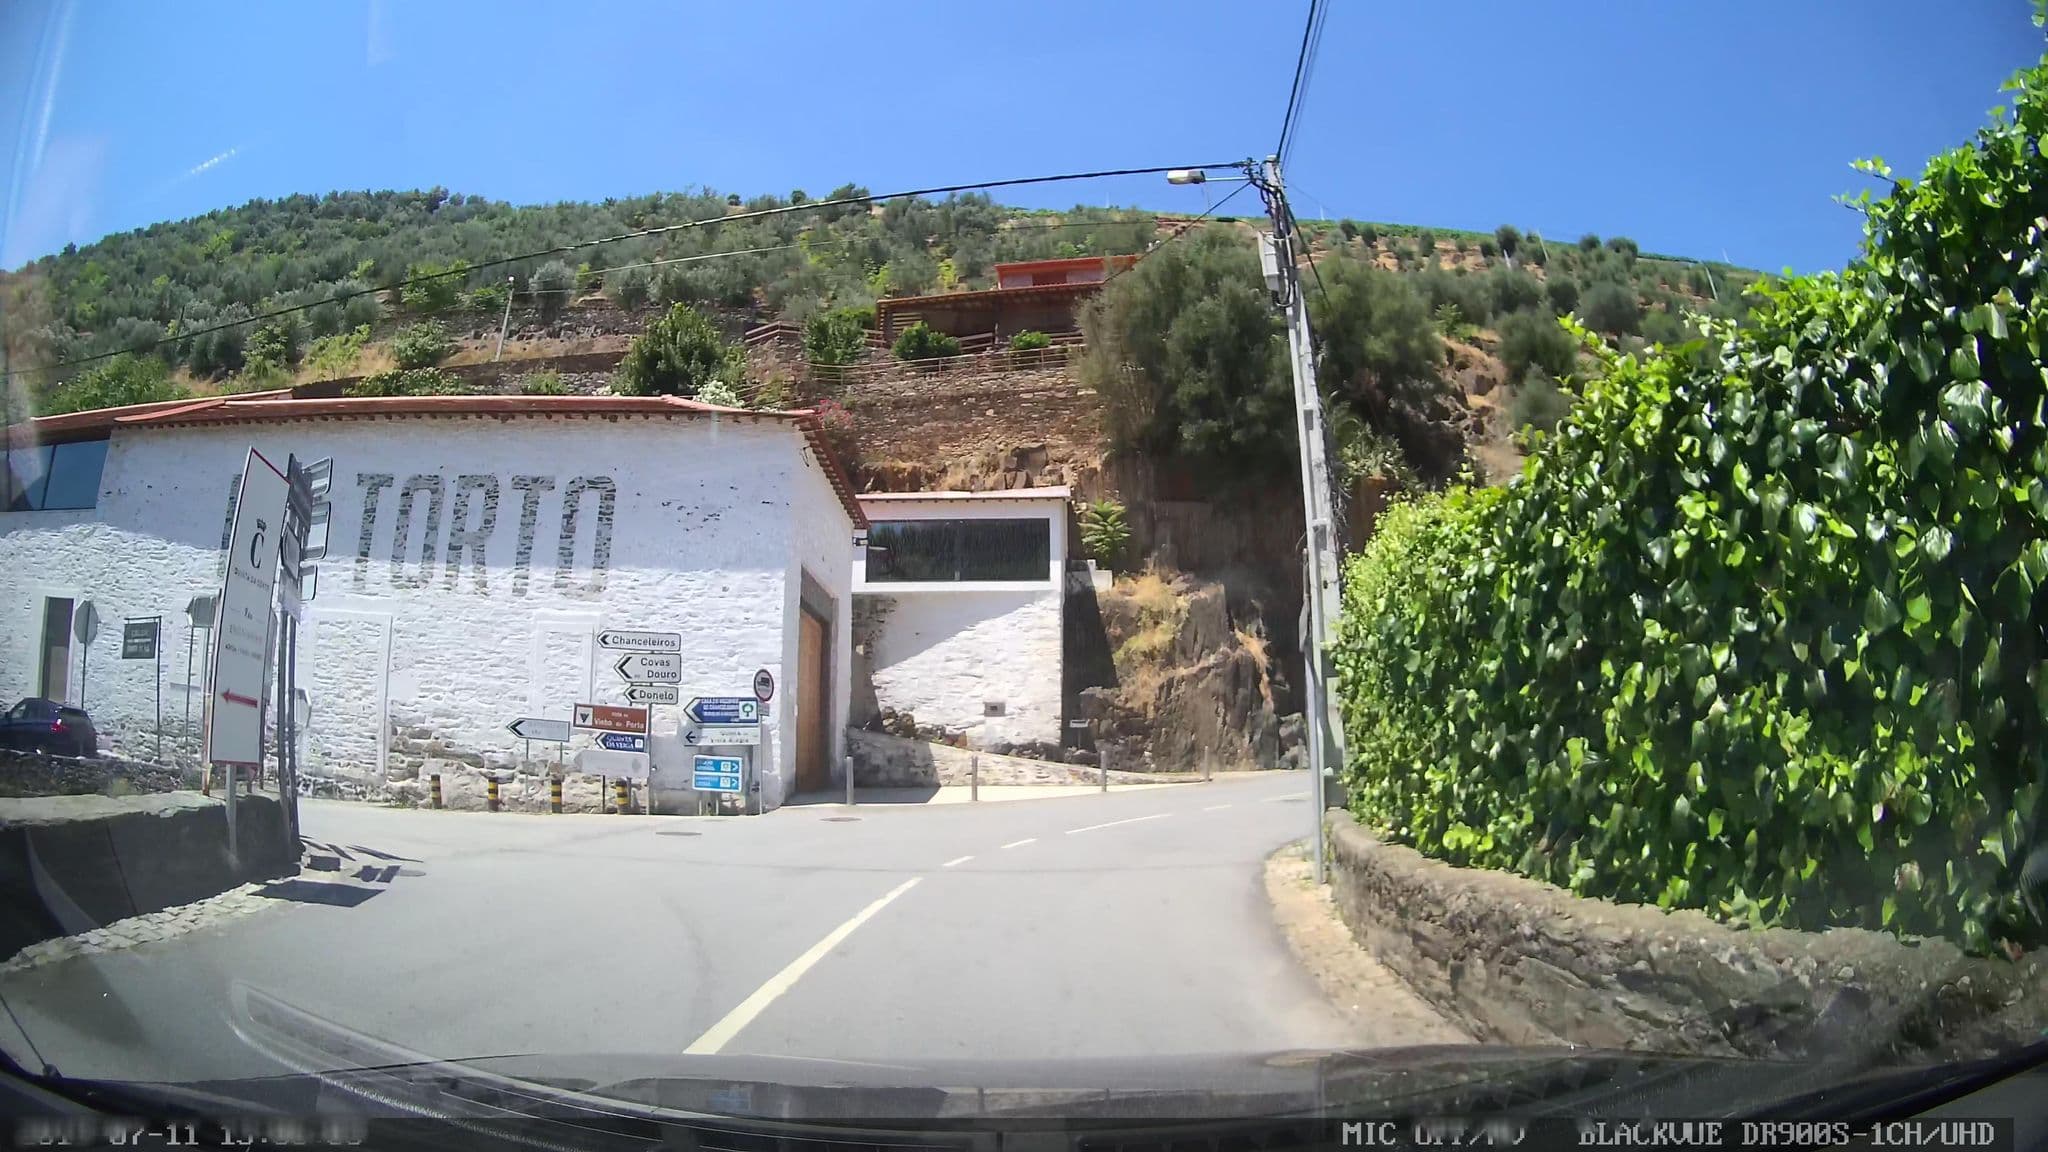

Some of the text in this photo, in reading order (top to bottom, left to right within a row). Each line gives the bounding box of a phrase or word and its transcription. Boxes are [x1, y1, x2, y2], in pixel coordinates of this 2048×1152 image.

[354, 474, 617, 596] TORTO
[612, 635, 676, 647] Chanceleiros
[640, 657, 671, 667] Covas
[647, 670, 677, 679] Douro
[639, 690, 674, 700] Donelo
